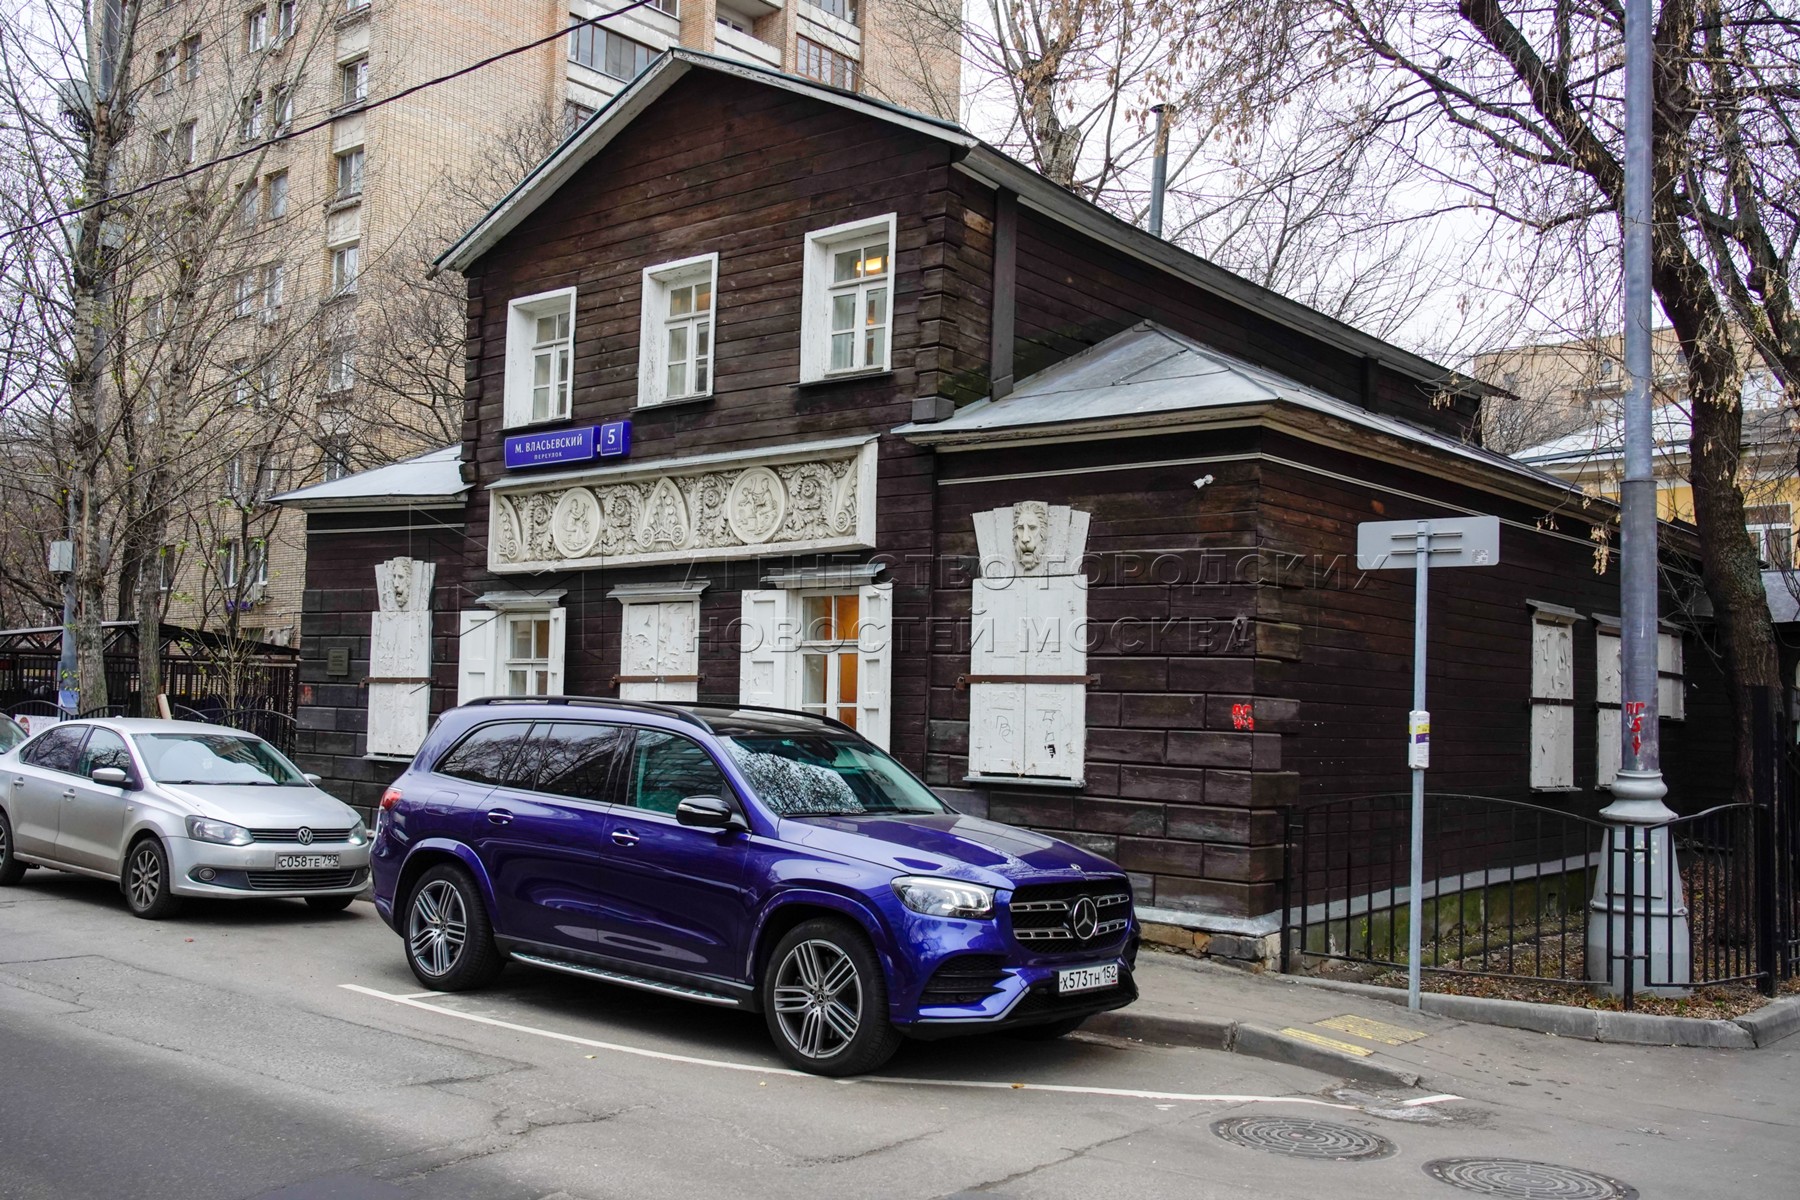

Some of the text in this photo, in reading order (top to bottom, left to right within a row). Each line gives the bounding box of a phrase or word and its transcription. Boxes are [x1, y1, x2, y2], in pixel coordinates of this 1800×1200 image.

[515, 434, 583, 453] М. ВЛАСЬЕВСКИЙ
[607, 429, 616, 444] 5
[534, 452, 562, 460] ПЕРЕУЛОК
[1102, 966, 1116, 979] 152
